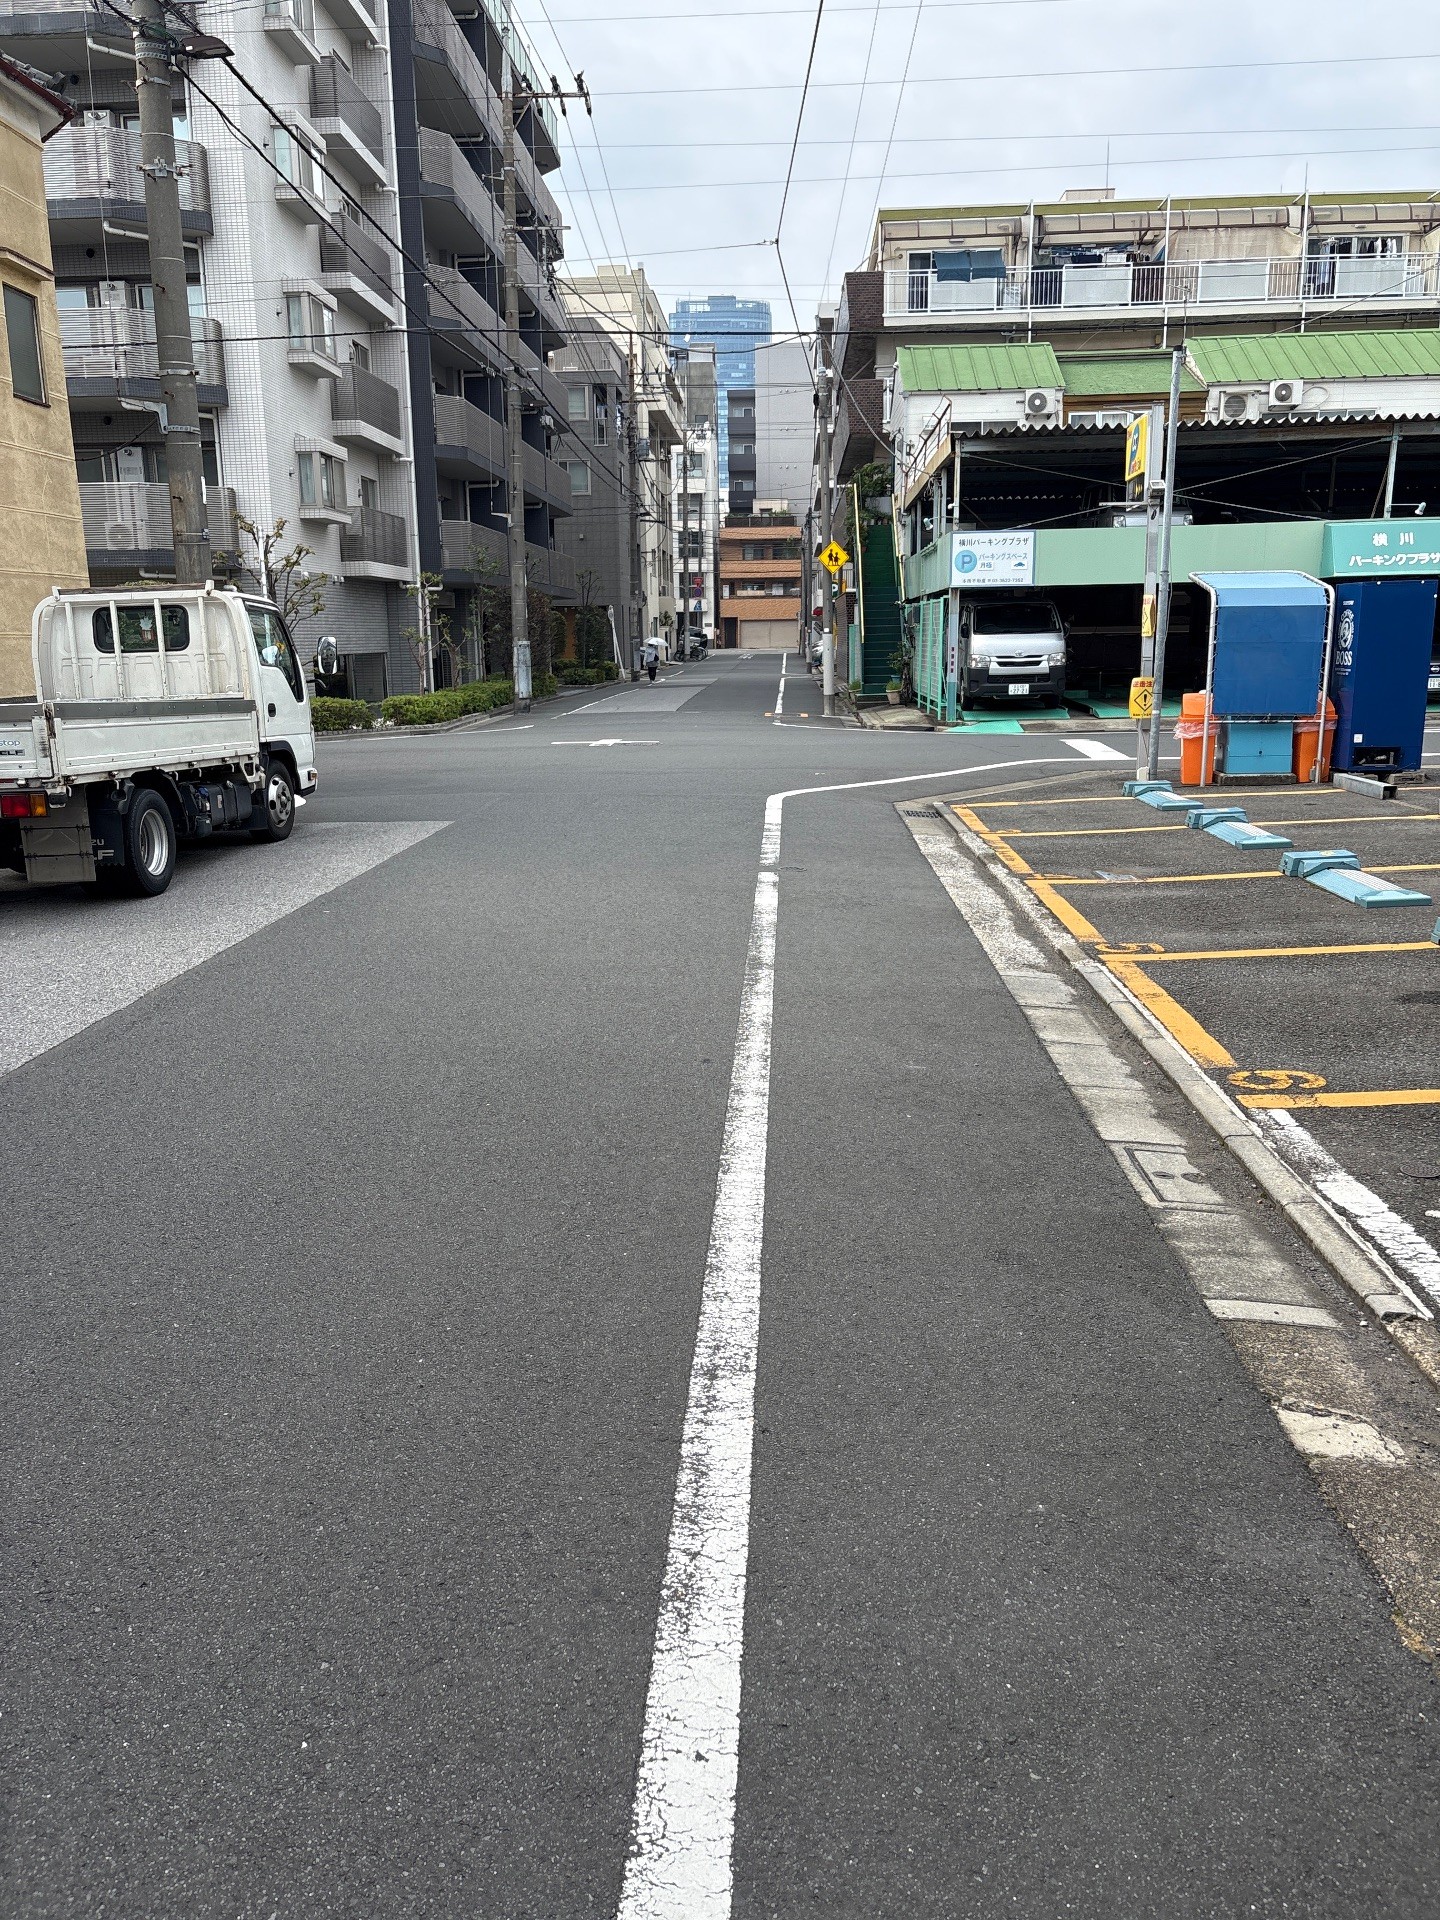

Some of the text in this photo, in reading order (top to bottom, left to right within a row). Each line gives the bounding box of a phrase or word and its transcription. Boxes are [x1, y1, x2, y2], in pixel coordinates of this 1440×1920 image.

[958, 536, 1030, 547] 横川パーキングプラザ
[961, 554, 973, 570] P
[978, 552, 1028, 561] パーキングスペース
[1335, 650, 1353, 666] BOSS
